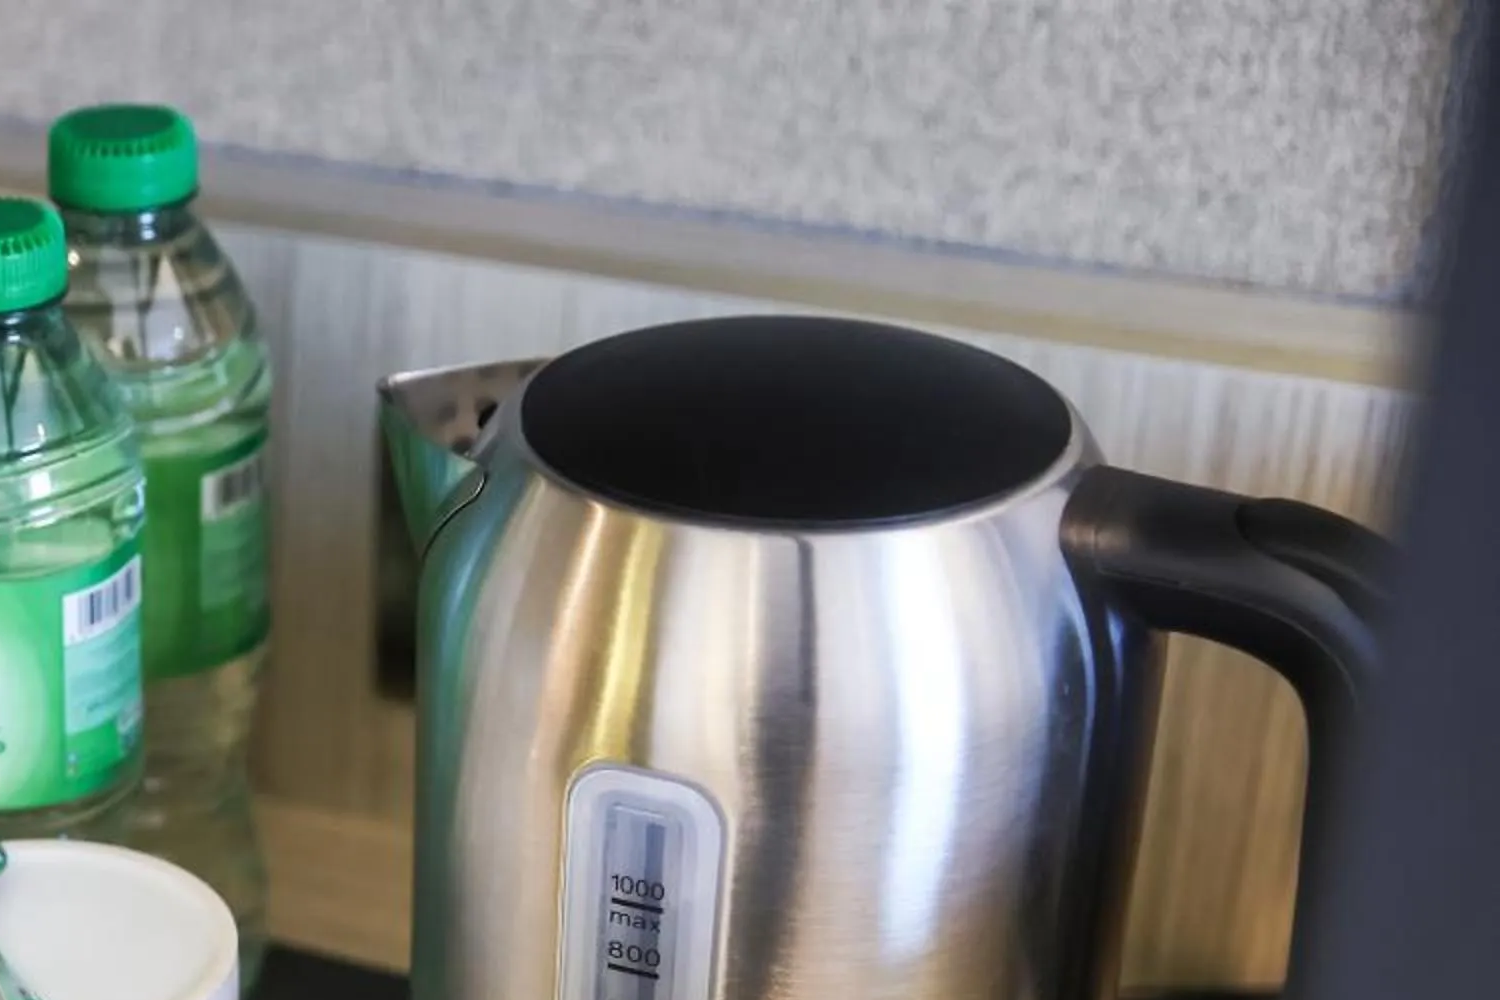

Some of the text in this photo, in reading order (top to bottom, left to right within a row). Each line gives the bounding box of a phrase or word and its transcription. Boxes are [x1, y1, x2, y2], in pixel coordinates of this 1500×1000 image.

[611, 873, 665, 901] 1000
[609, 909, 661, 934] max
[607, 940, 661, 968] 800
